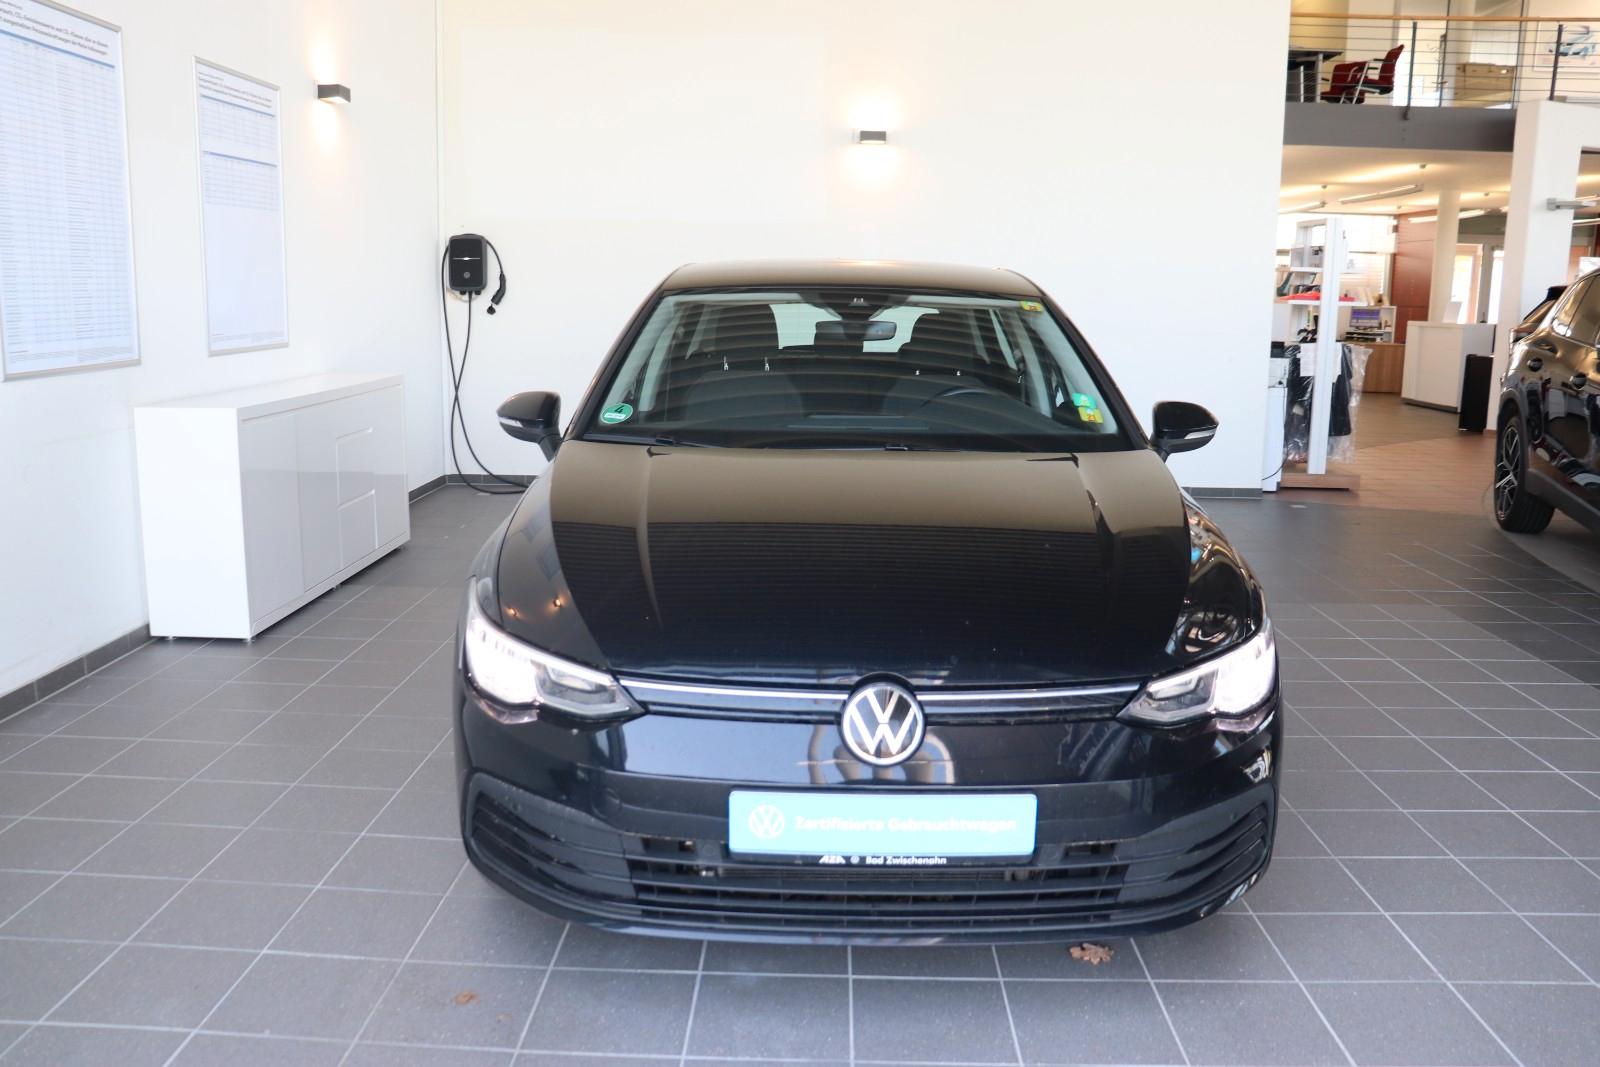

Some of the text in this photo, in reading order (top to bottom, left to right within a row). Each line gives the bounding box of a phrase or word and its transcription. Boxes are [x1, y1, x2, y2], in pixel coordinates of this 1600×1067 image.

[614, 405, 625, 413] 4
[887, 816, 1017, 835] Gebrauchtwagen
[865, 855, 885, 864] Bad
